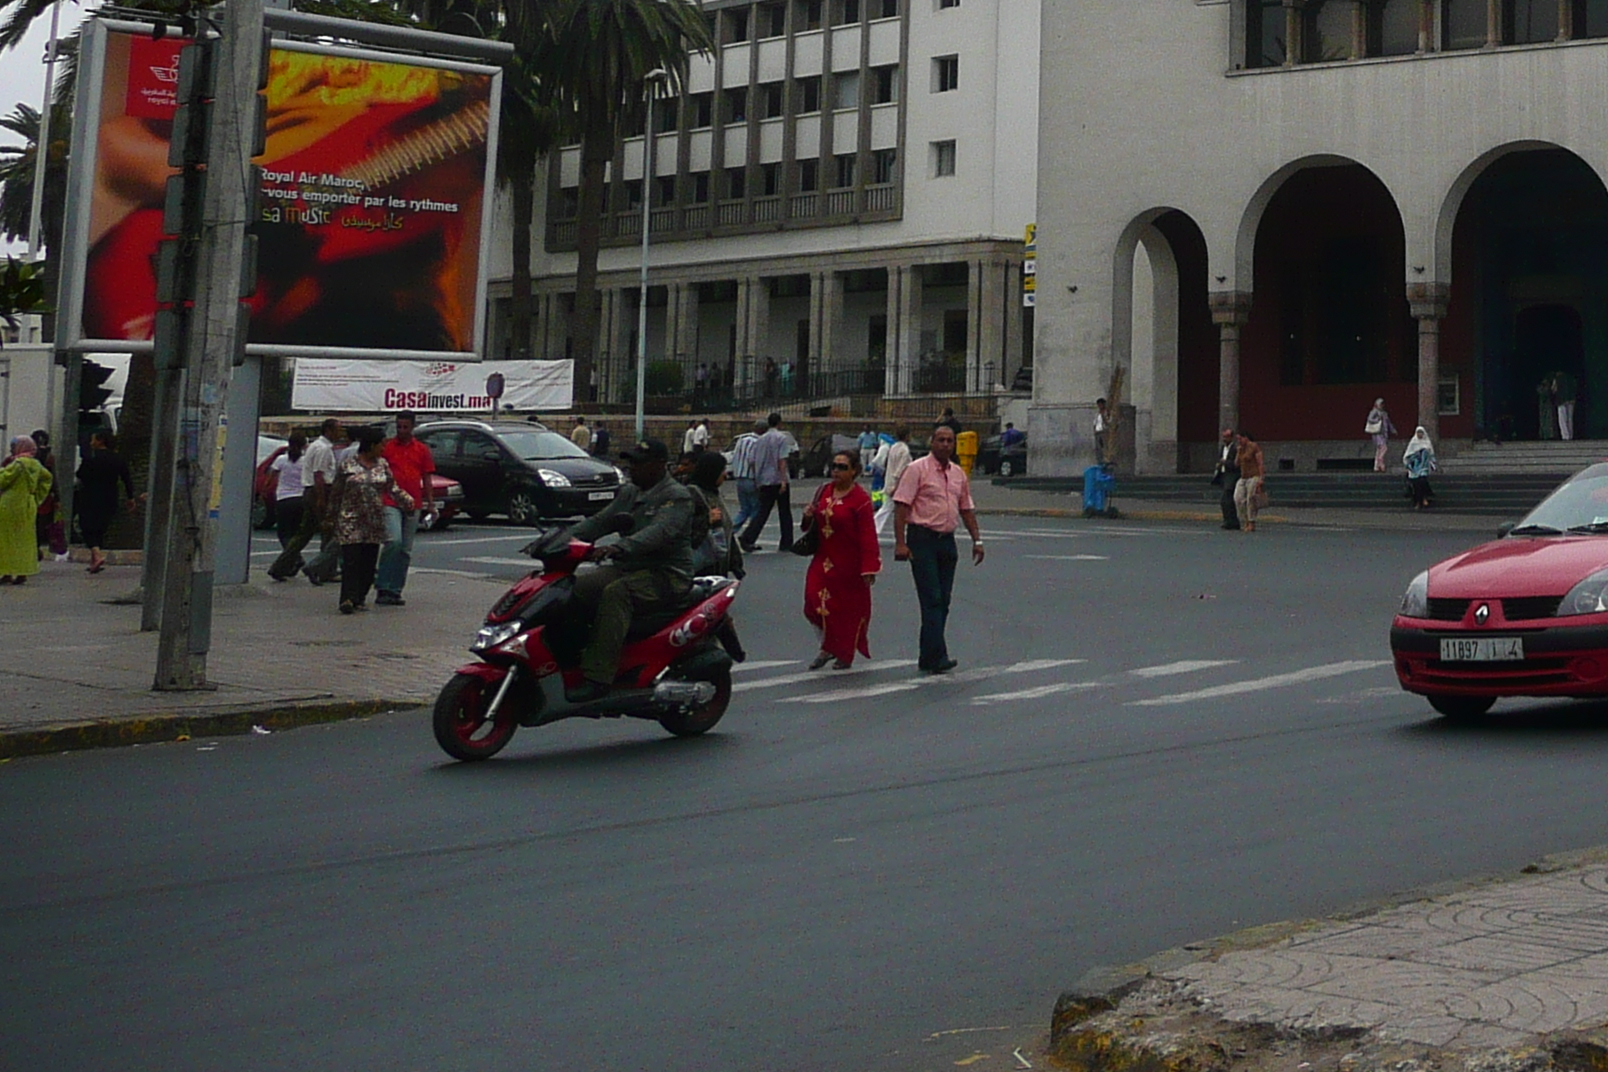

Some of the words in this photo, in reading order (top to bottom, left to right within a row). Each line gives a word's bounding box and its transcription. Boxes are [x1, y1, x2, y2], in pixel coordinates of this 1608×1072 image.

[299, 171, 317, 184] Air
[320, 174, 365, 190] Maroc,
[302, 191, 361, 206] emporter
[364, 197, 385, 208] par
[388, 195, 406, 208] les
[409, 198, 459, 213] rythmes
